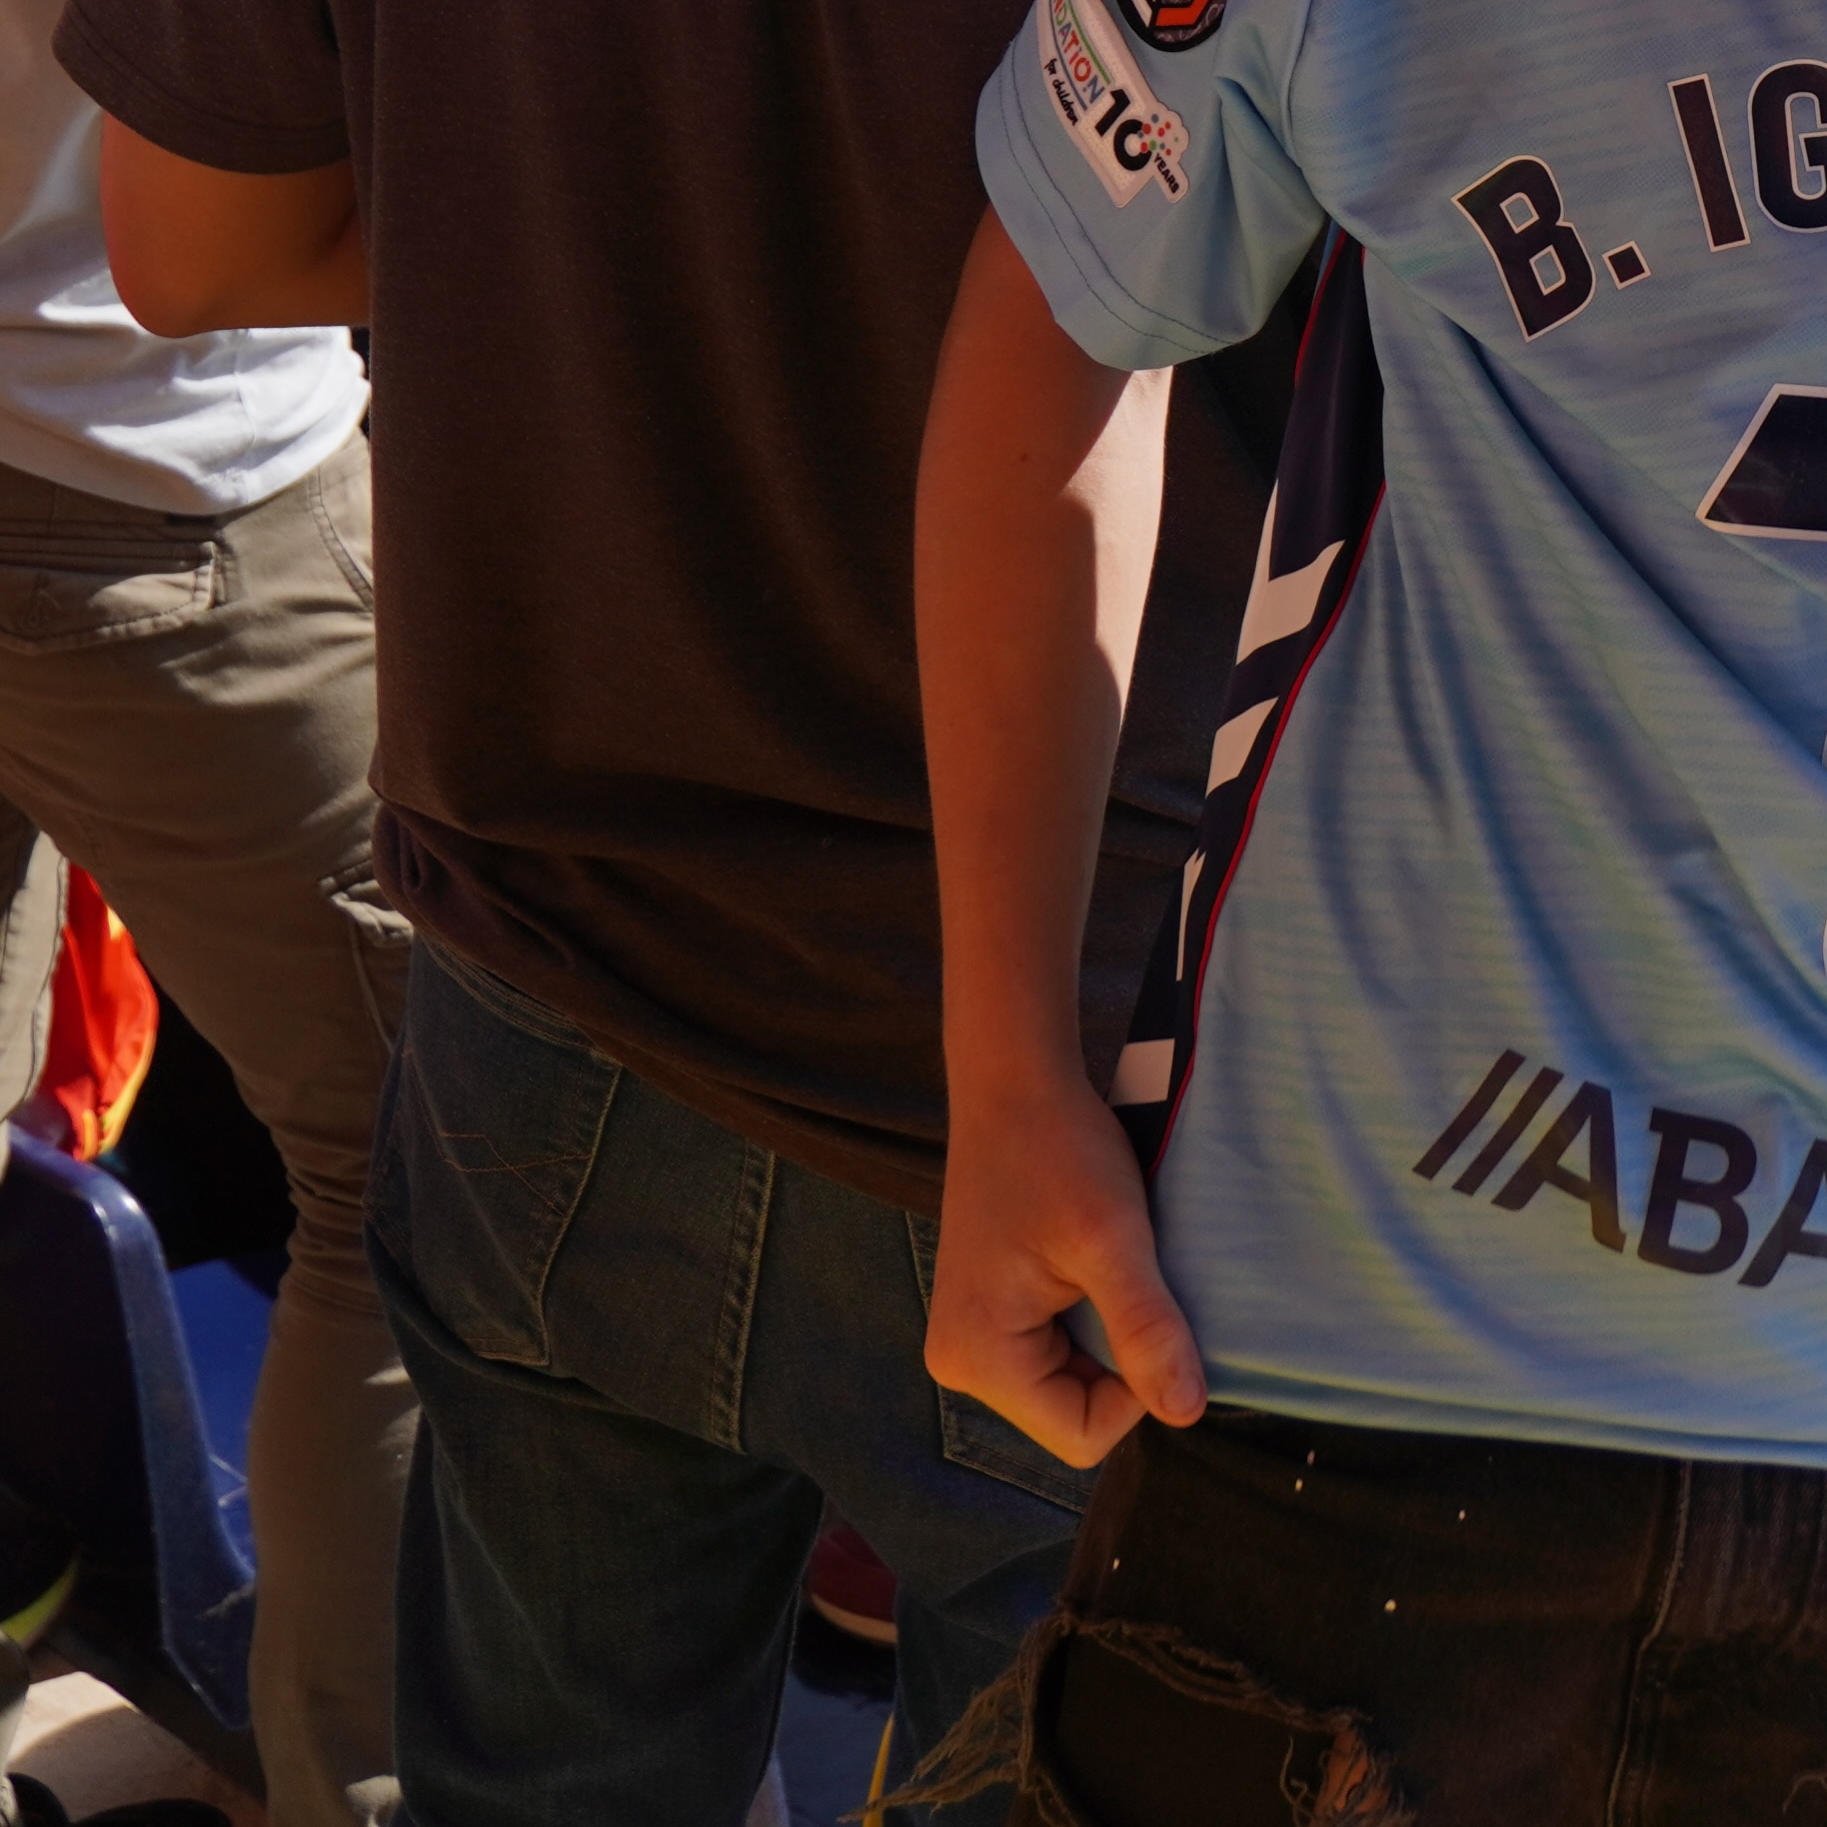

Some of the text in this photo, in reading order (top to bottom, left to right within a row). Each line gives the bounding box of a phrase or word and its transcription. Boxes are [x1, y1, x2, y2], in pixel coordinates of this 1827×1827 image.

[1044, 58, 1079, 126] for children
[1094, 88, 1154, 172] 10
[1153, 152, 1180, 195] YEARS
[1451, 154, 1652, 342] B.
